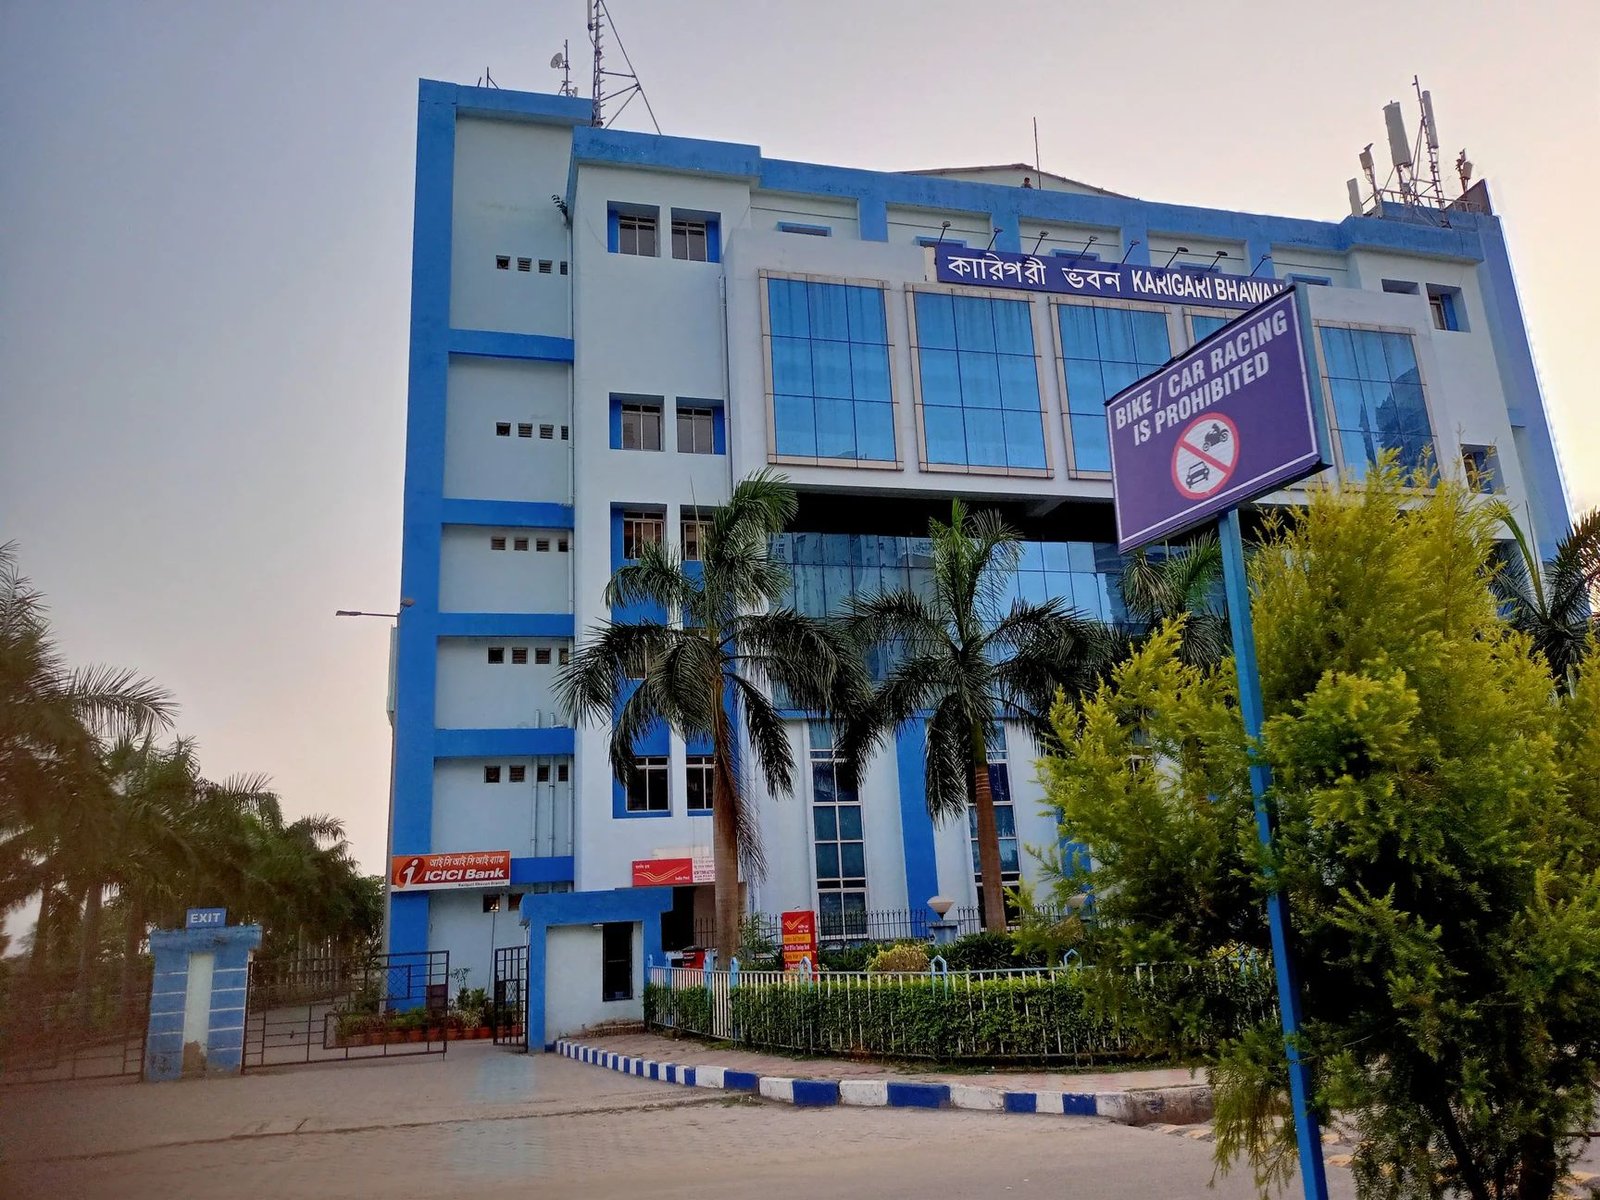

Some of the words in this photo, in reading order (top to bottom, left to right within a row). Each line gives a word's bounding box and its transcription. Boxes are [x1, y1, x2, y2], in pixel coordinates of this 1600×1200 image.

[947, 253, 1047, 285] কারিগরী
[1062, 267, 1121, 292] ভবন
[1131, 269, 1215, 299] KARIGARI
[1115, 390, 1153, 430] BIKE
[1168, 360, 1206, 398] CAR
[1210, 309, 1288, 374] RACING
[1133, 424, 1151, 447] IS
[1155, 351, 1270, 435] PROHIBITED
[424, 869, 463, 881] ICICI
[465, 867, 504, 880] Bank
[191, 912, 221, 923] EXIT
